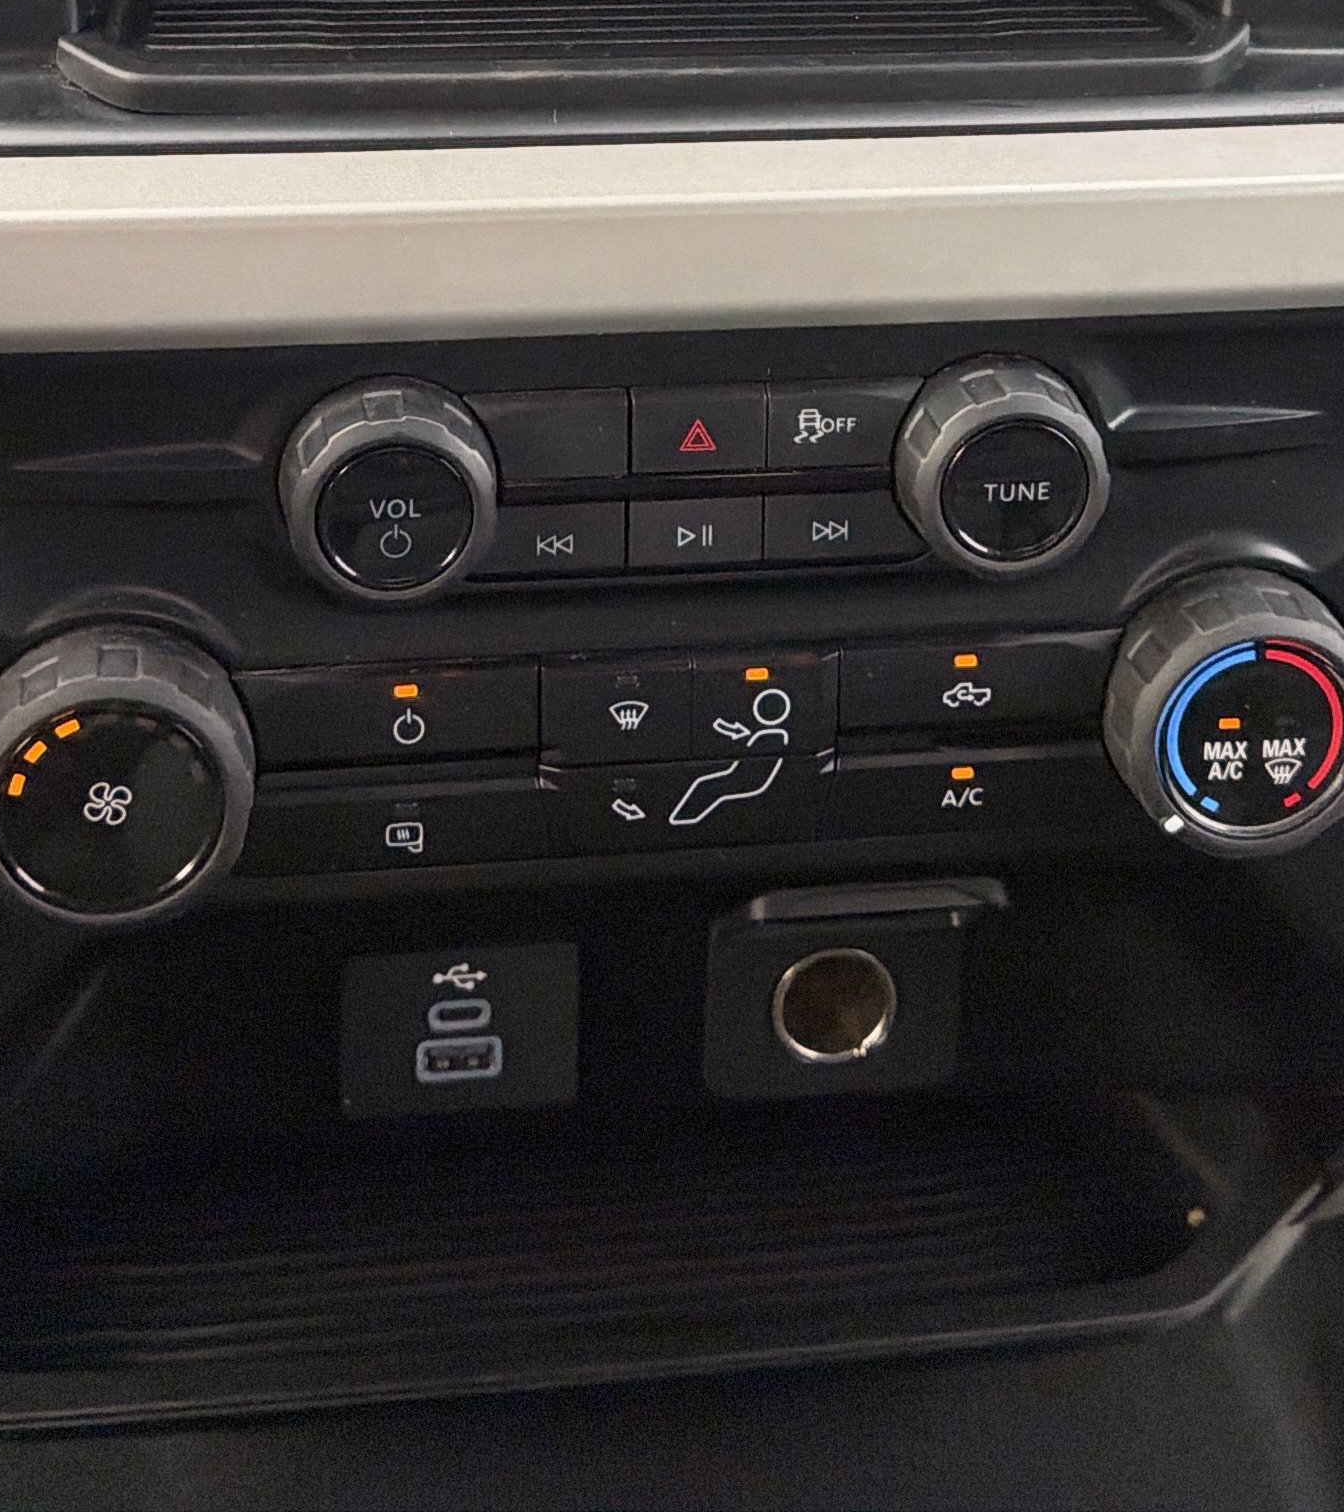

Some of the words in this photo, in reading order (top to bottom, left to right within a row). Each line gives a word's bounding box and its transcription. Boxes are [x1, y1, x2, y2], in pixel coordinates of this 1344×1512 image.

[822, 414, 857, 435] OFF
[984, 481, 1051, 504] TUNE
[369, 498, 422, 519] VOL
[1204, 741, 1248, 760] MAX
[1262, 738, 1306, 757] MAX
[1208, 761, 1244, 780] A/C
[942, 787, 983, 809] A/C
